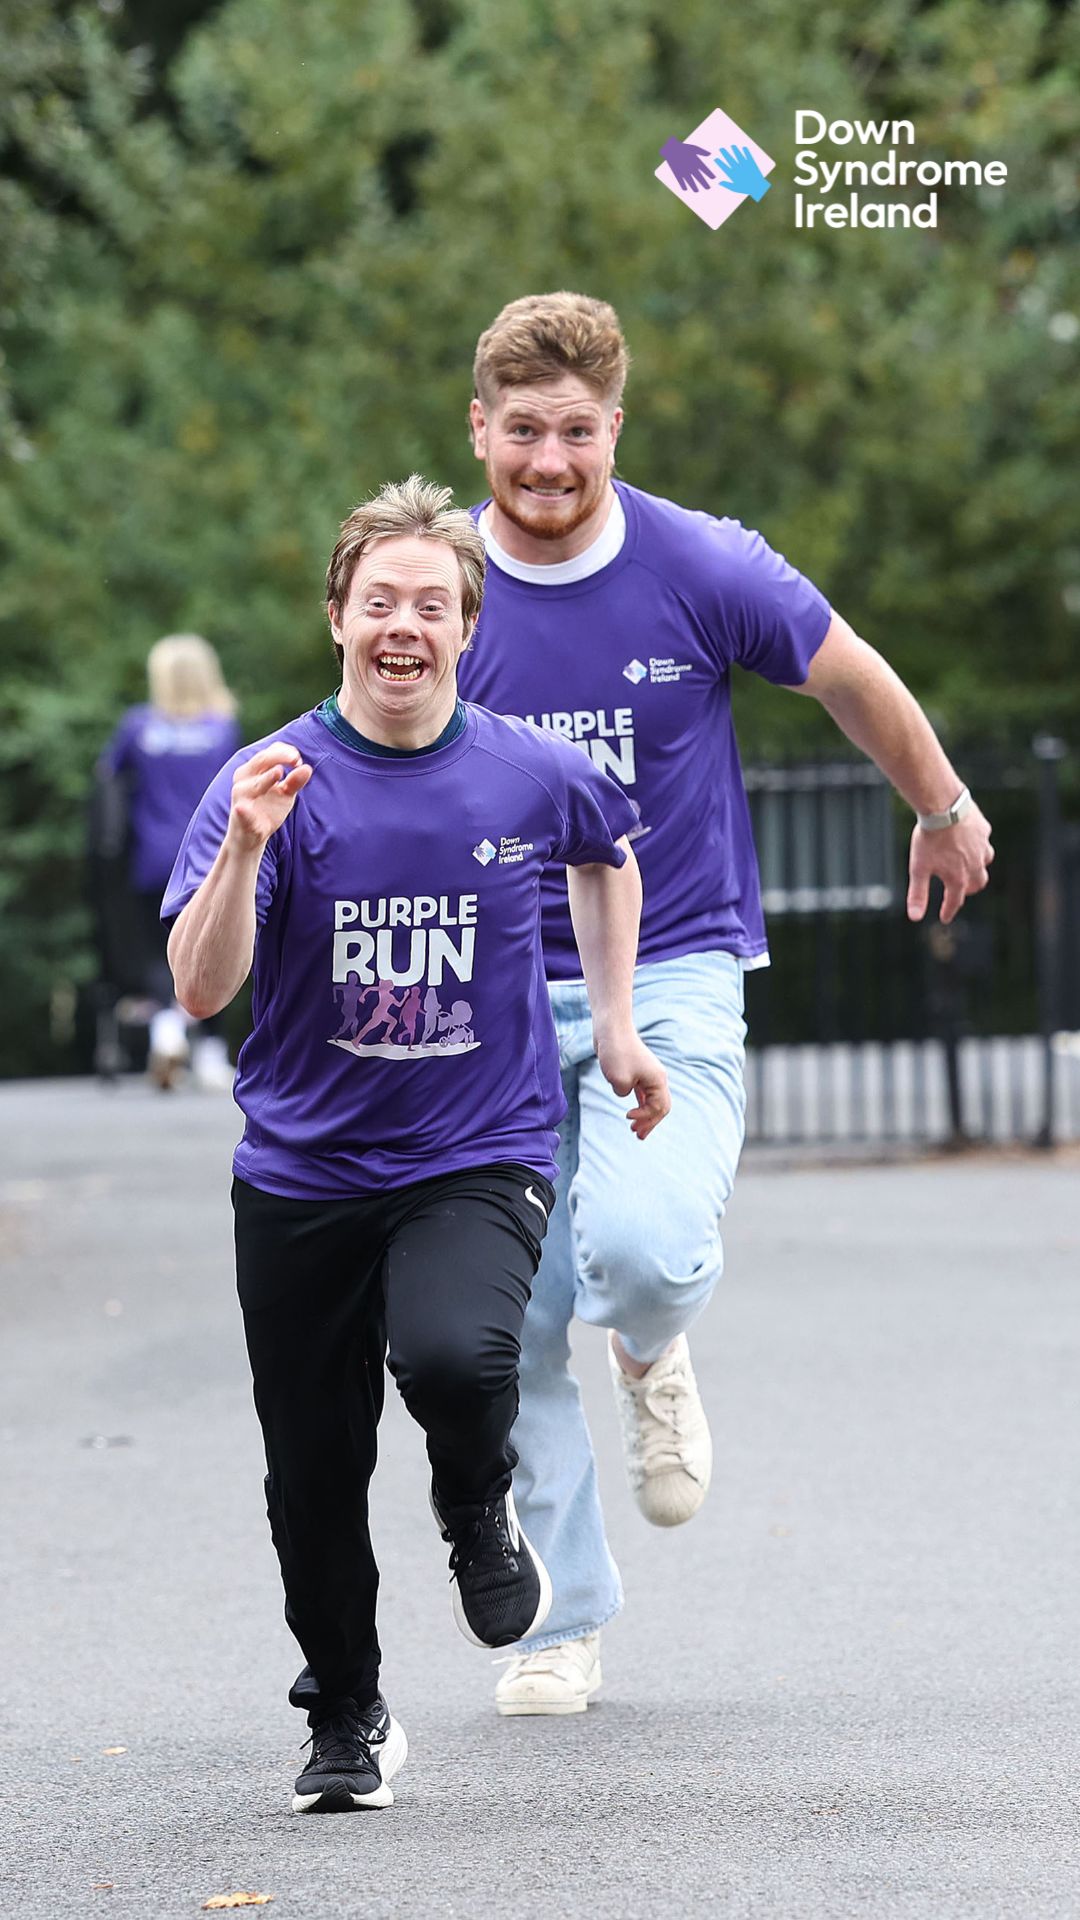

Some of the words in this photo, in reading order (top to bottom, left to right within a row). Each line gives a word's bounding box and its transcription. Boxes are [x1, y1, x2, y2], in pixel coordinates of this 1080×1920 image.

[649, 658, 675, 667] Down
[525, 707, 635, 740] RPLE
[500, 837, 521, 846] Down
[499, 843, 534, 856] Syndrome
[498, 852, 524, 865] Ireland
[334, 894, 478, 930] PURPLE
[332, 927, 476, 987] RUN
